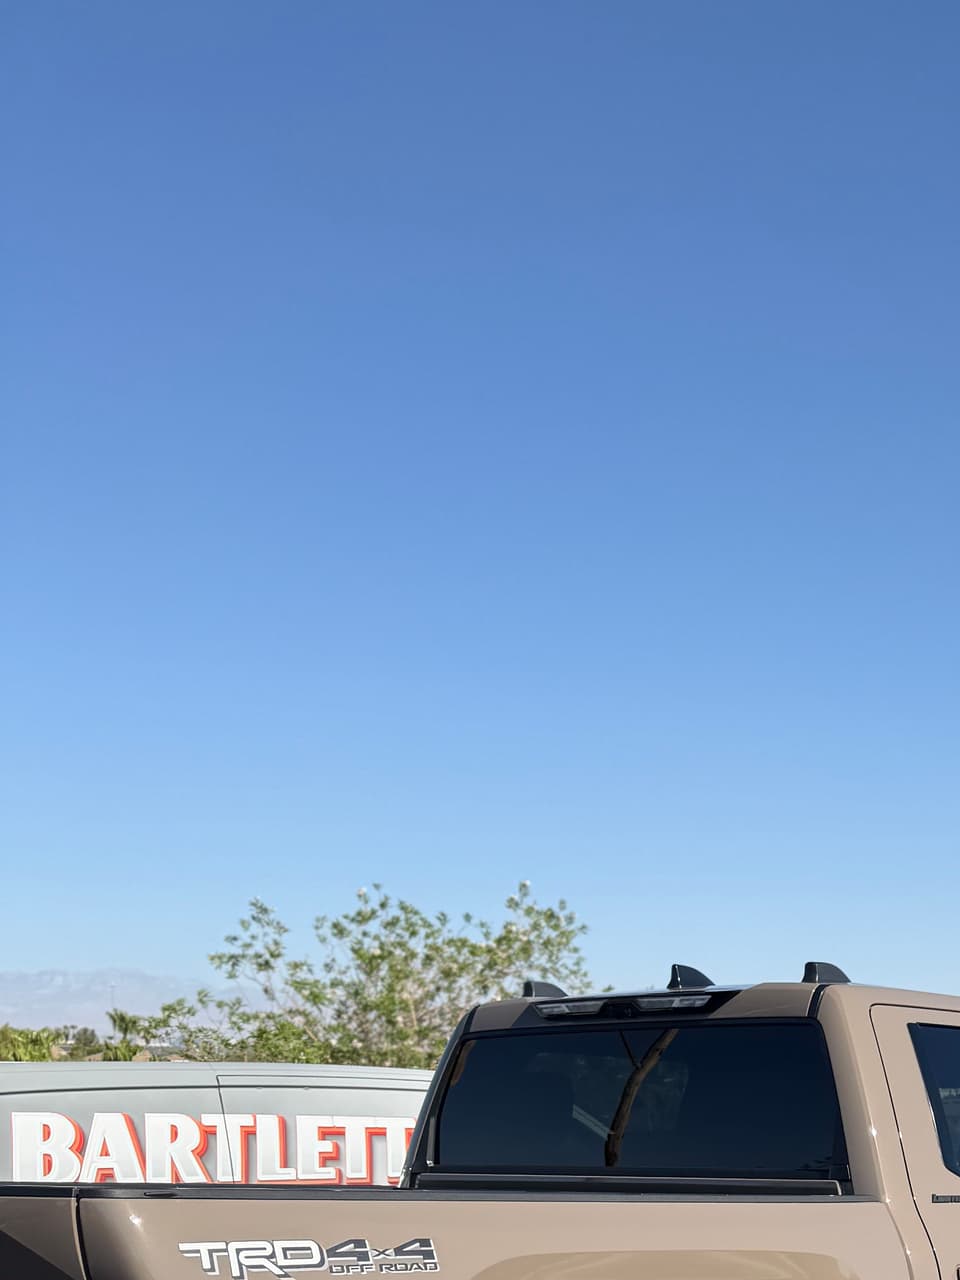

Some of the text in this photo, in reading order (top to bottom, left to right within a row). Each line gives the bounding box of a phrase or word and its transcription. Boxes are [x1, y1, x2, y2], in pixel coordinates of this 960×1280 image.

[11, 1112, 417, 1184] BARTLETT
[325, 1238, 438, 1263] 4x4
[328, 1262, 440, 1275] OFF ROAD
